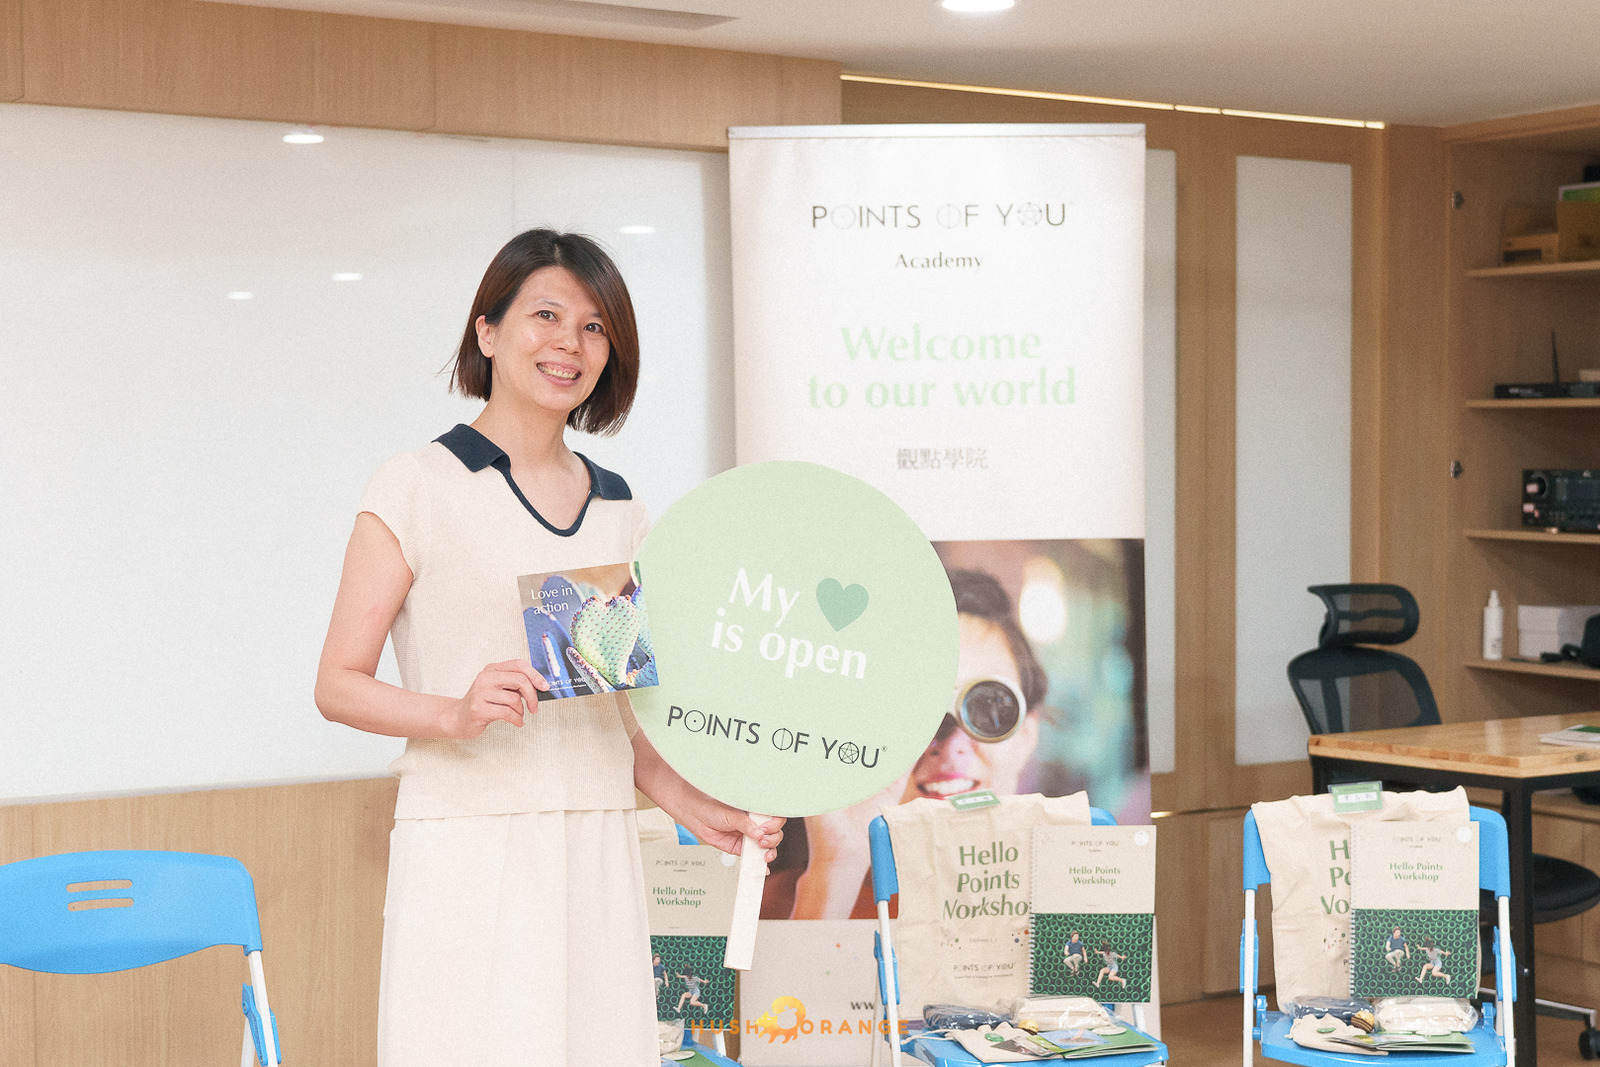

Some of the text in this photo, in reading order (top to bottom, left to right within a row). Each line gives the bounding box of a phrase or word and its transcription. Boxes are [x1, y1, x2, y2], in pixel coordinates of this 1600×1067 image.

[811, 203, 922, 231] POINTS
[936, 203, 979, 230] OF
[894, 251, 984, 273] Academy
[840, 322, 1042, 363] Welcome
[807, 366, 1076, 409] to our world
[896, 446, 989, 471] 觀點學院
[531, 585, 573, 601] Love in
[727, 567, 801, 628] My
[533, 601, 569, 616] action
[710, 607, 868, 680] is open
[666, 704, 761, 746] POINTS
[772, 727, 810, 754] OF
[958, 840, 1019, 867] Hello
[1389, 861, 1444, 871] Hello Points
[957, 868, 1020, 894] Points
[1068, 865, 1121, 875] Hello Points
[1073, 876, 1117, 887] Workshop
[1393, 871, 1439, 882] Workshop
[652, 886, 706, 896] Hello Points
[656, 897, 702, 909] Workshop
[943, 893, 1029, 920] Worksho
